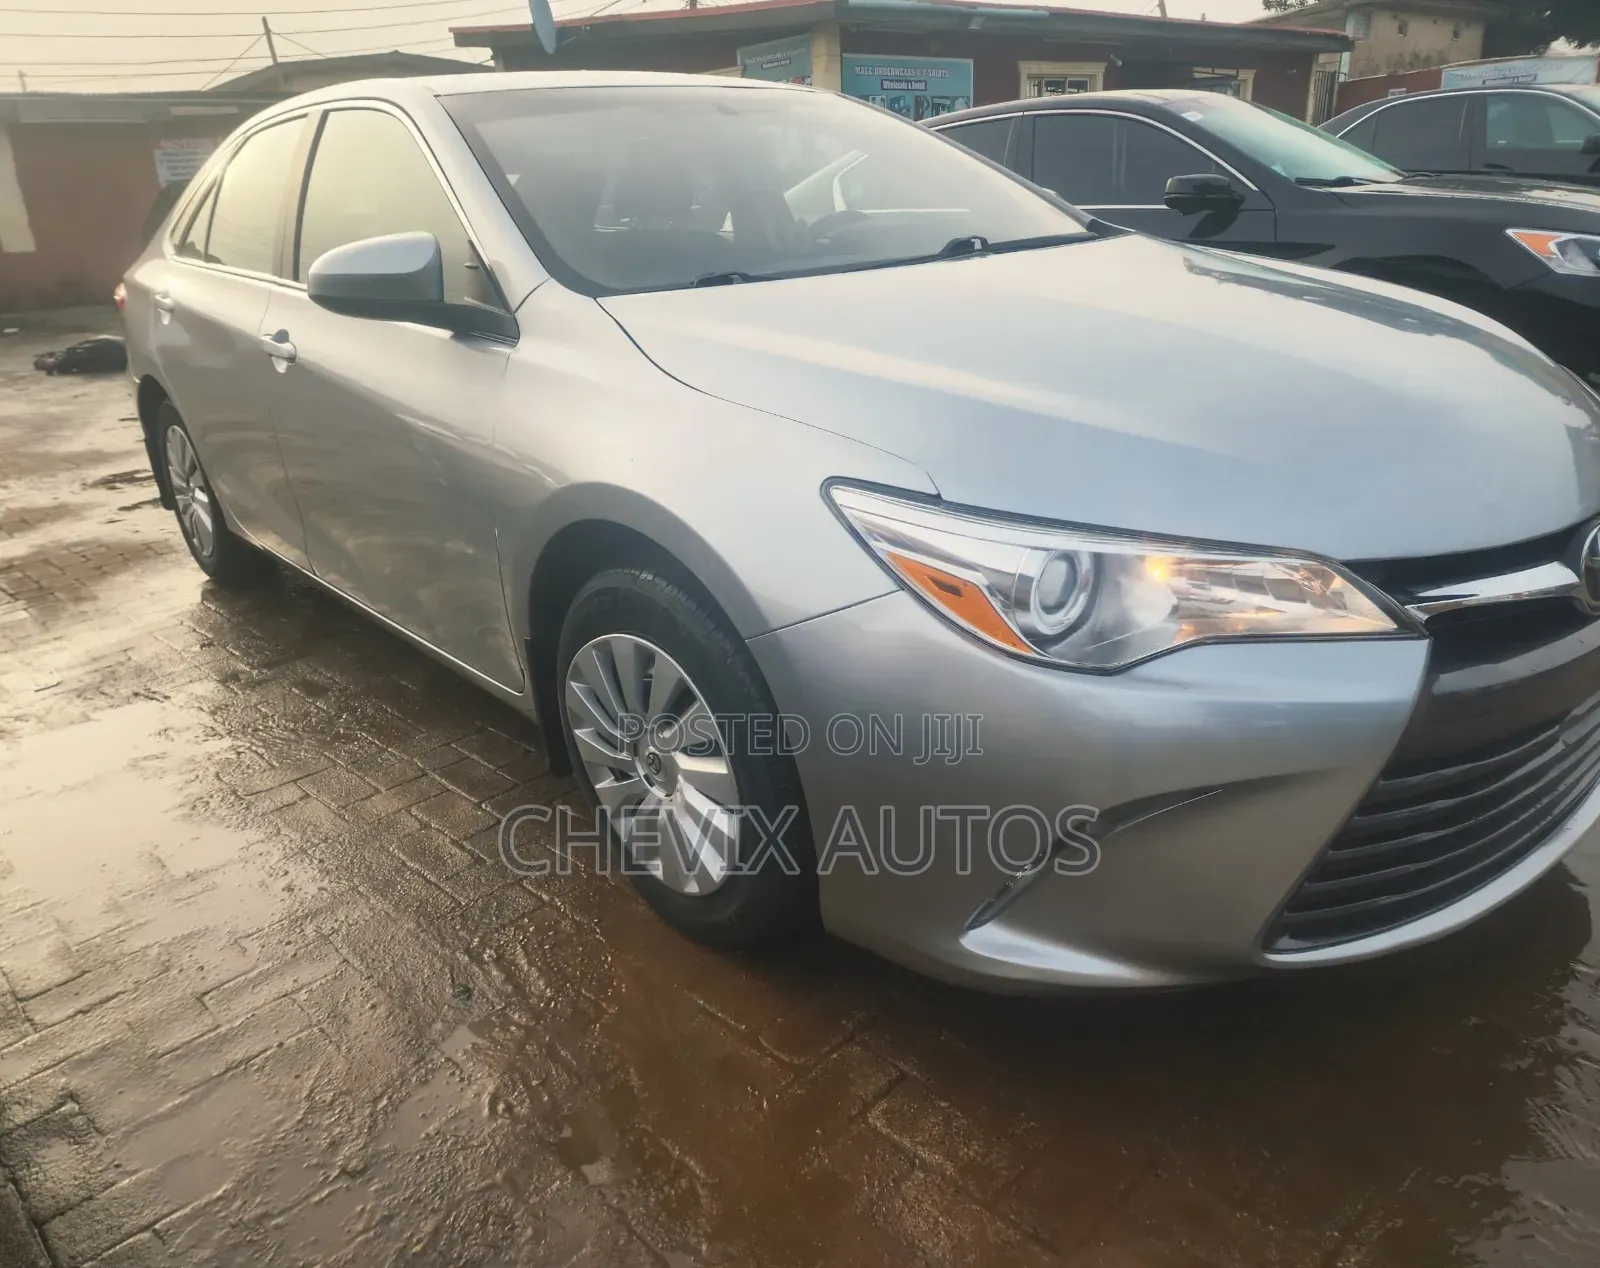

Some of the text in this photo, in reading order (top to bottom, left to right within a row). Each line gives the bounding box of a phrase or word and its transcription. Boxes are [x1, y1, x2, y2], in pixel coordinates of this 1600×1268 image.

[854, 66, 873, 76] MALE
[874, 66, 915, 77] UNDERWEARS
[923, 68, 950, 78] T-SHIRTS
